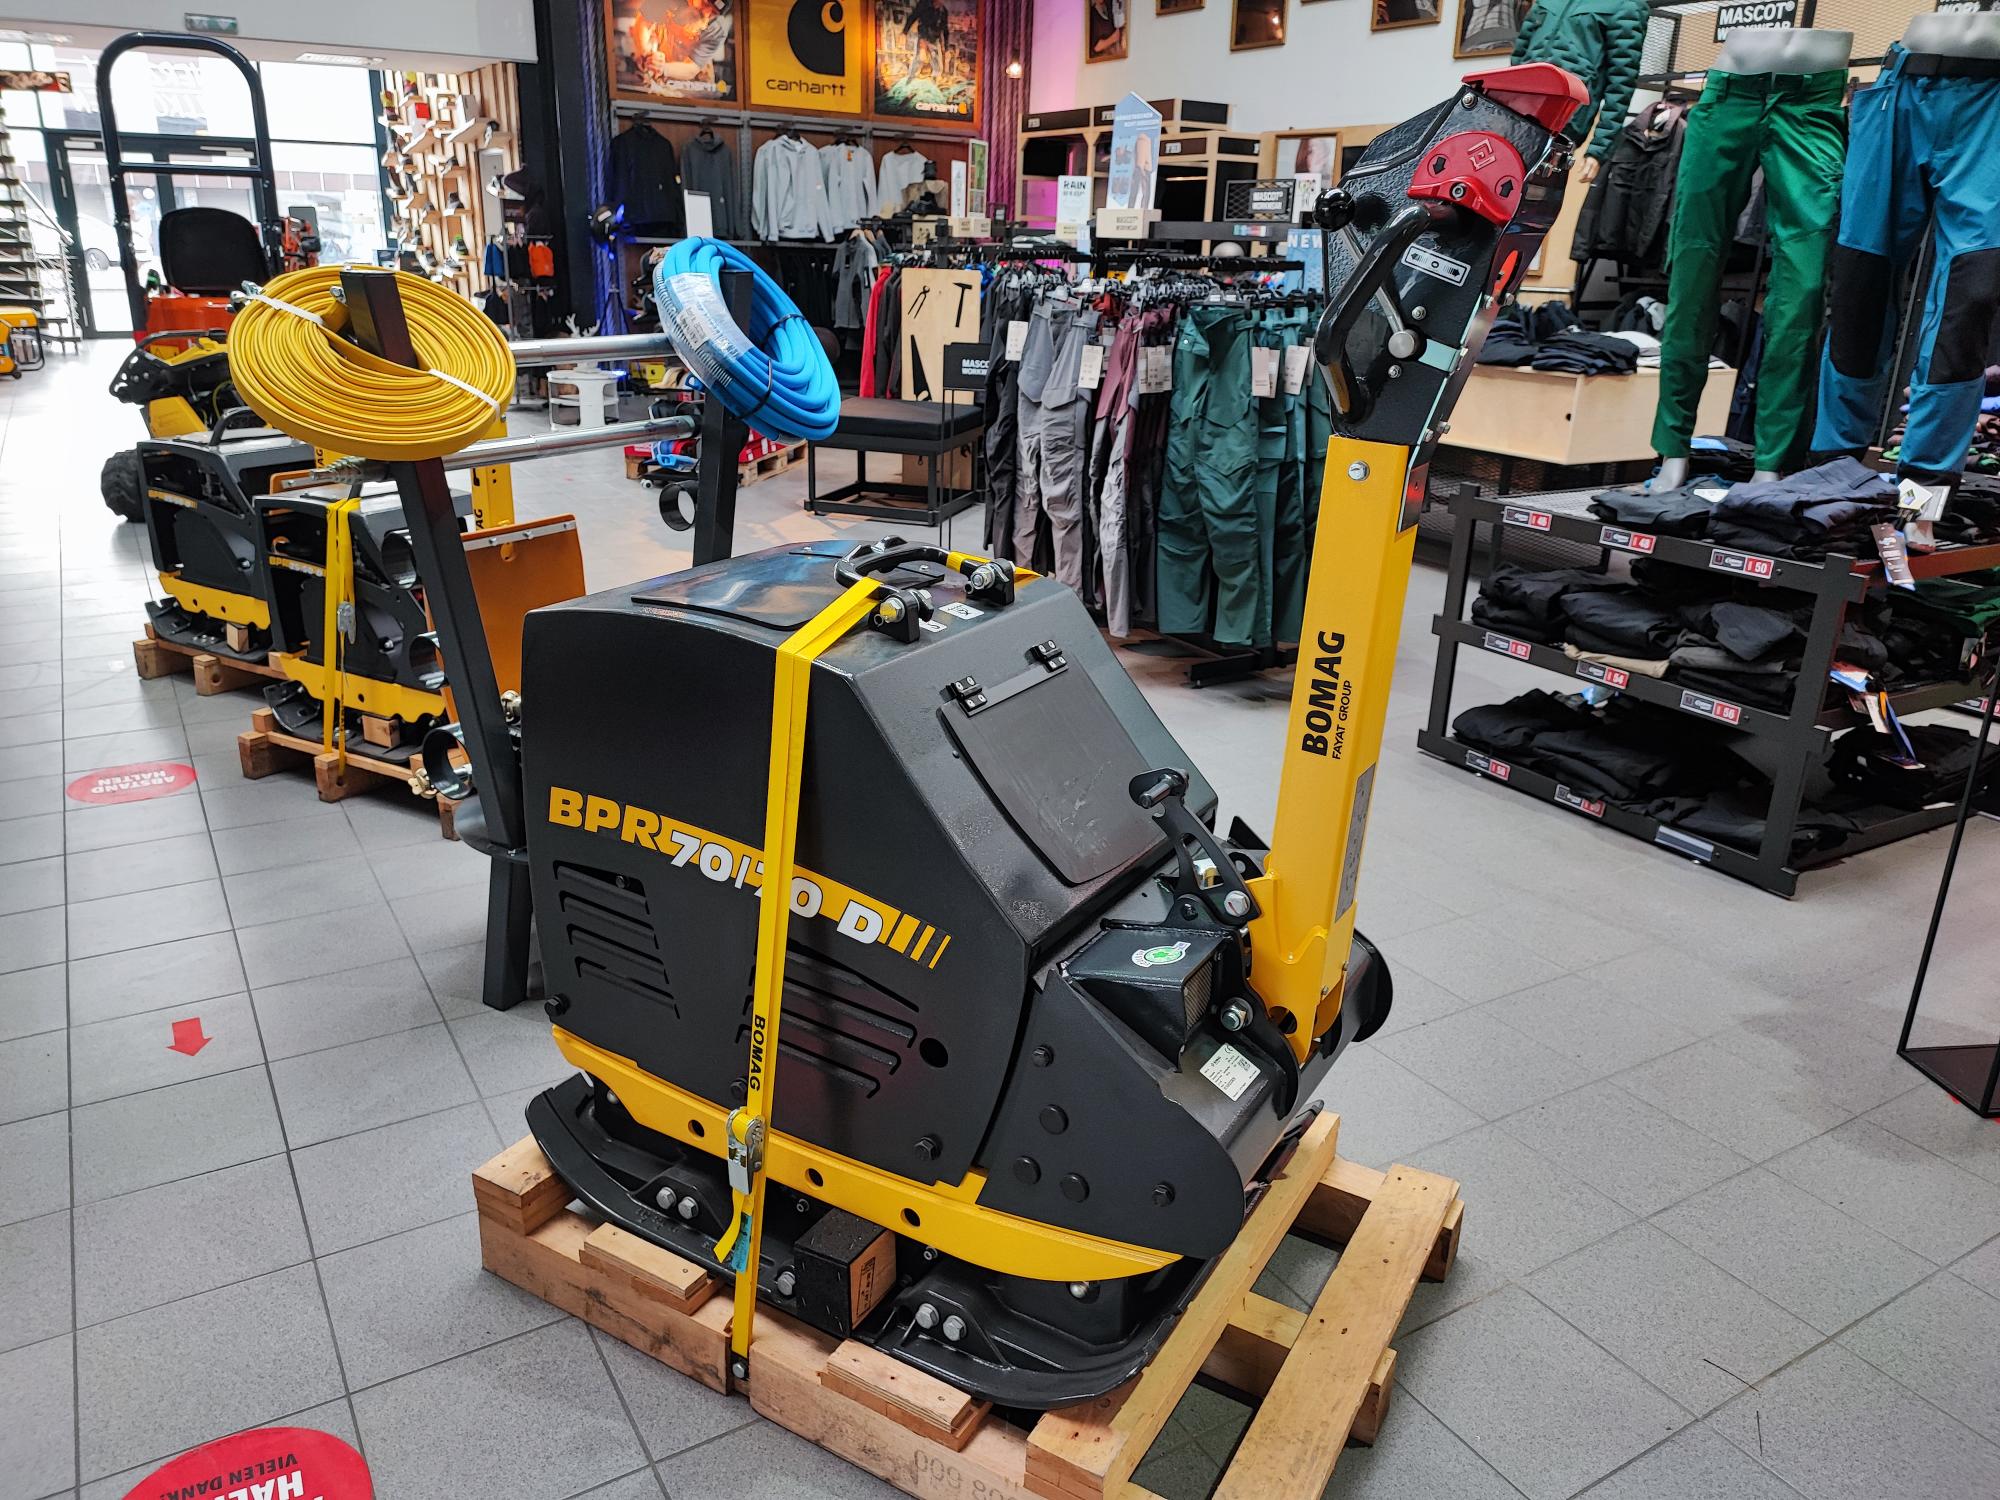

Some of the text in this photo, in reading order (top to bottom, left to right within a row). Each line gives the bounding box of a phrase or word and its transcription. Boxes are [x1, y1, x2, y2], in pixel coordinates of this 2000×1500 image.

[766, 78, 846, 97] carhartt
[962, 358, 990, 368] MASCO
[1302, 631, 1345, 757] BOMAG
[1332, 680, 1352, 760] FAYAT GROUP
[90, 775, 176, 794] ABSTAND
[97, 770, 167, 787] HALTEN
[837, 899, 884, 945] D
[749, 1014, 766, 1092] BOMAG
[229, 1453, 298, 1484] VIELEN
